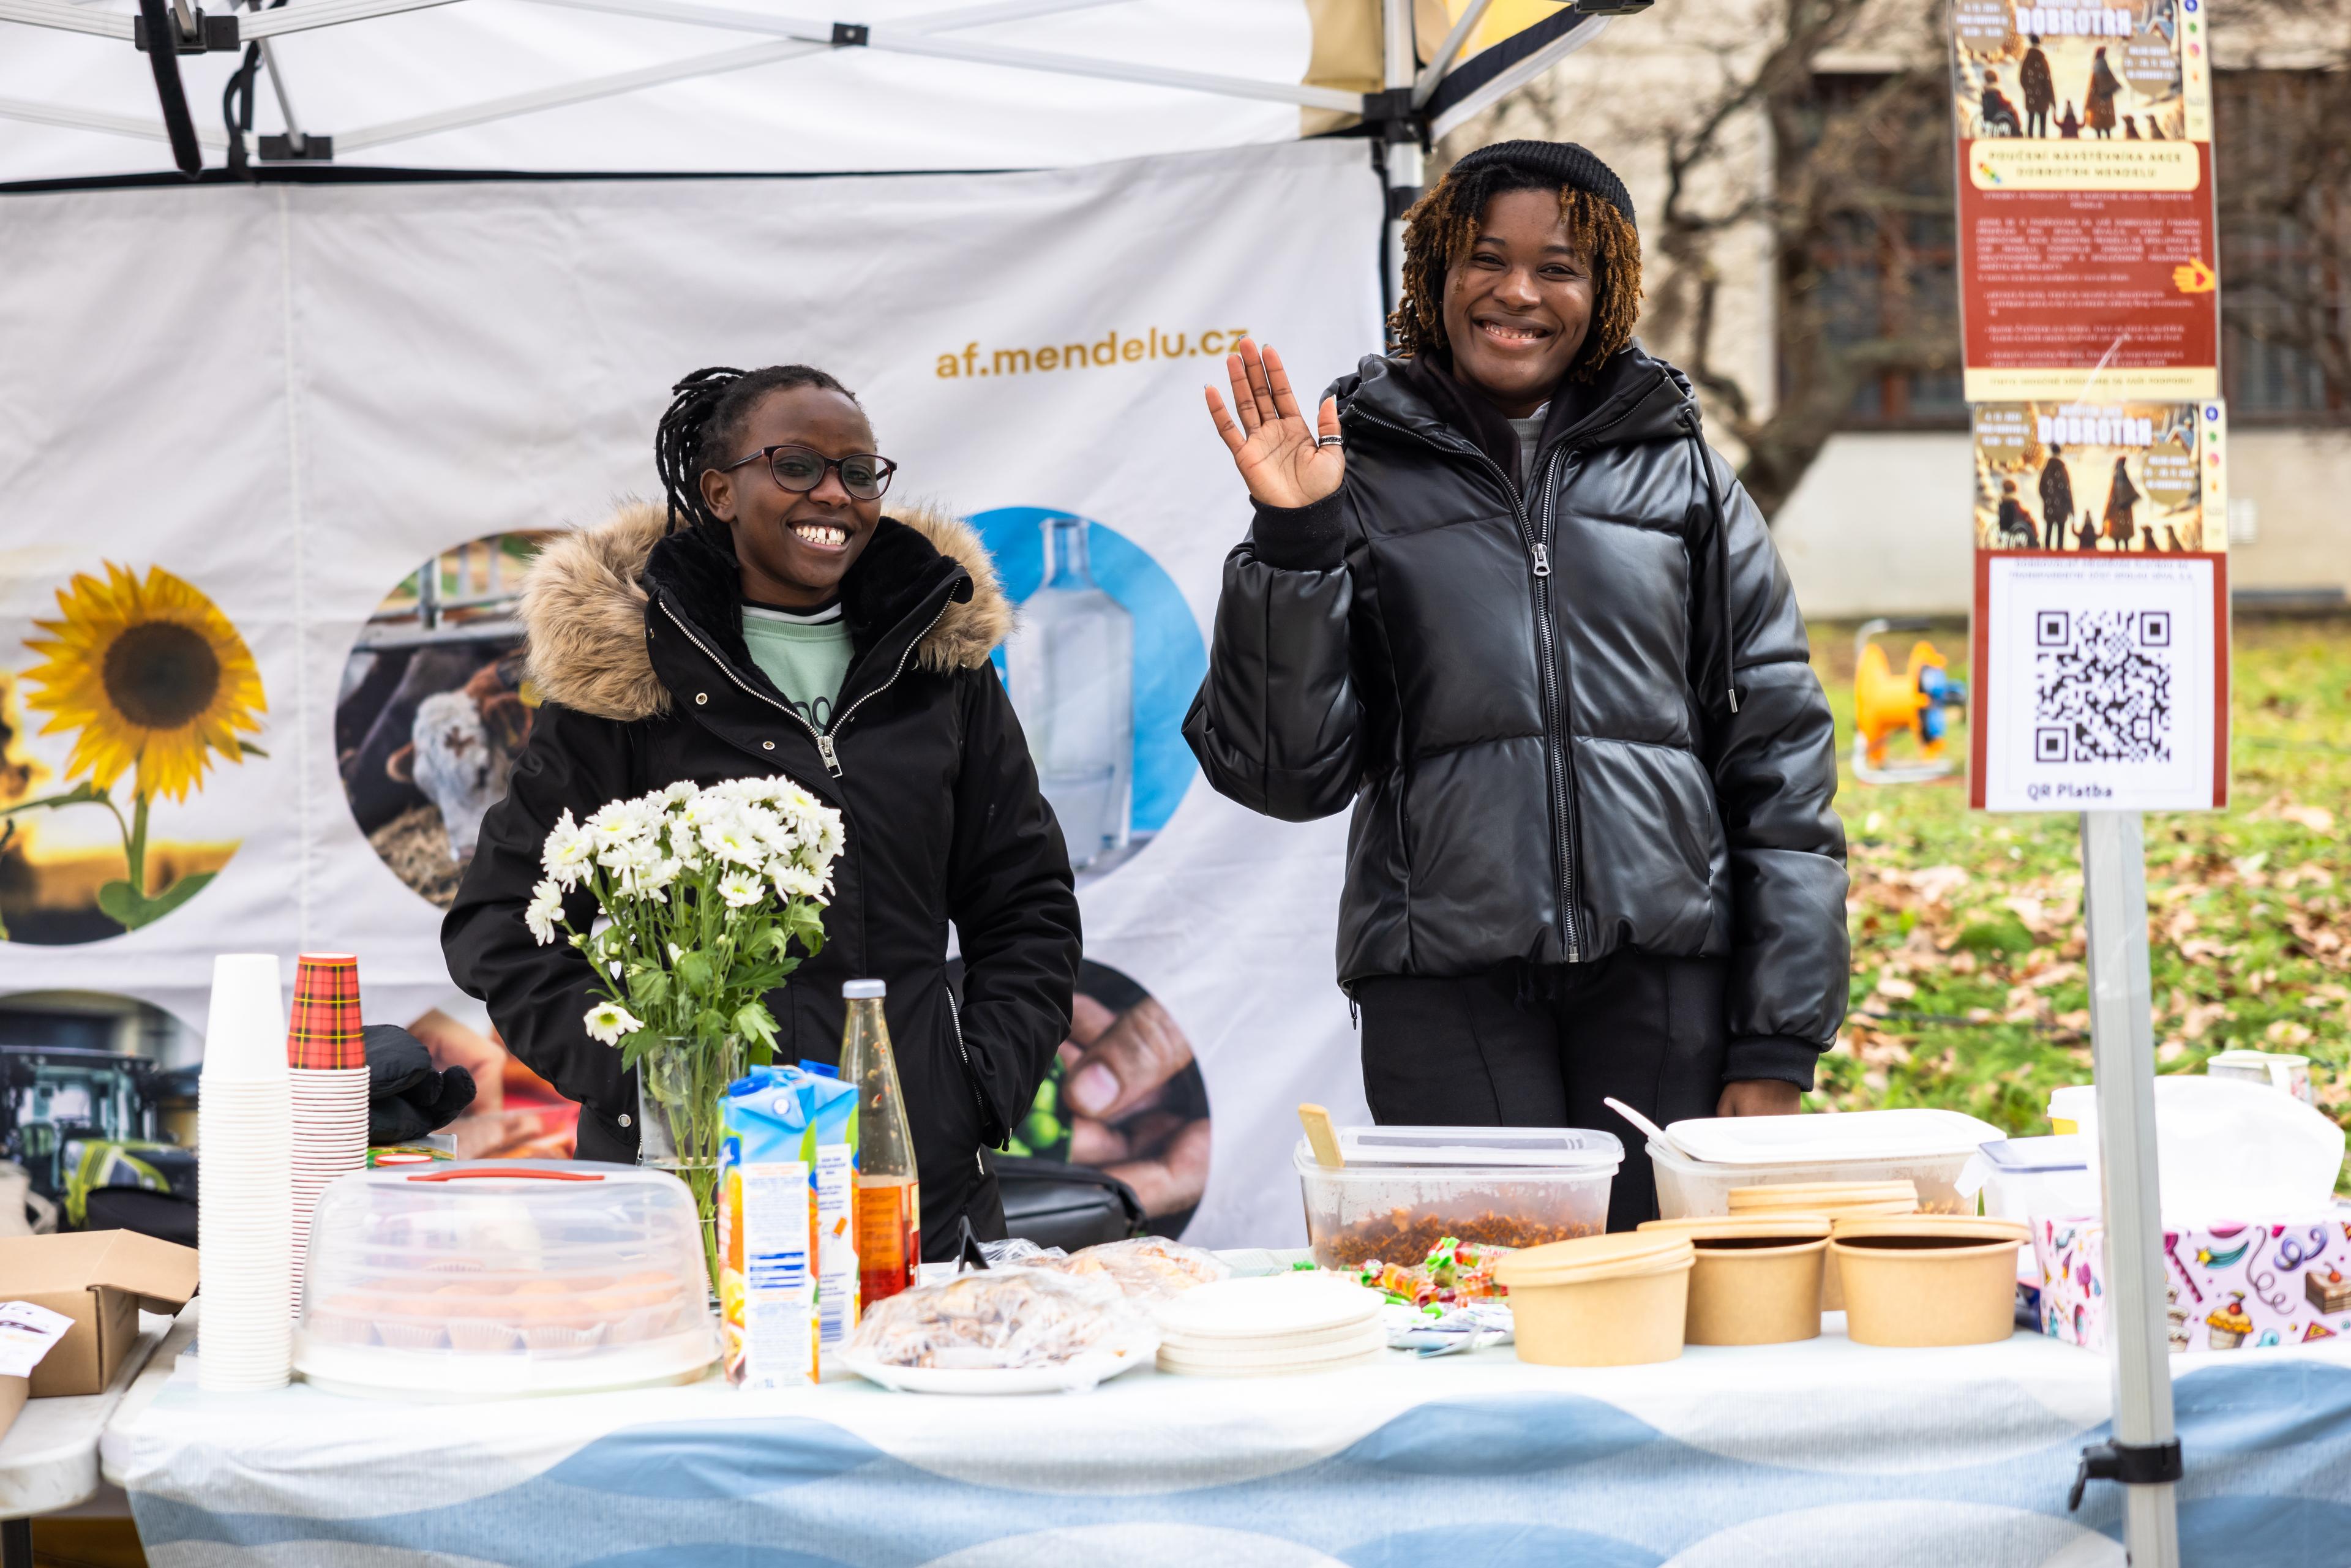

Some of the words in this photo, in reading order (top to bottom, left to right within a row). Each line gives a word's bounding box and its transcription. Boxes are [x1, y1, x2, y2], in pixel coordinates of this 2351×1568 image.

[2017, 7, 2132, 36] DOBROTRH
[2017, 167, 2089, 178] DOBROTRH
[2094, 168, 2157, 178] MENDELU
[936, 327, 1249, 380] af.mendelu.cz
[2038, 416, 2153, 446] DOBROTRH
[2028, 784, 2051, 801] QR
[2057, 784, 2112, 798] Platba
